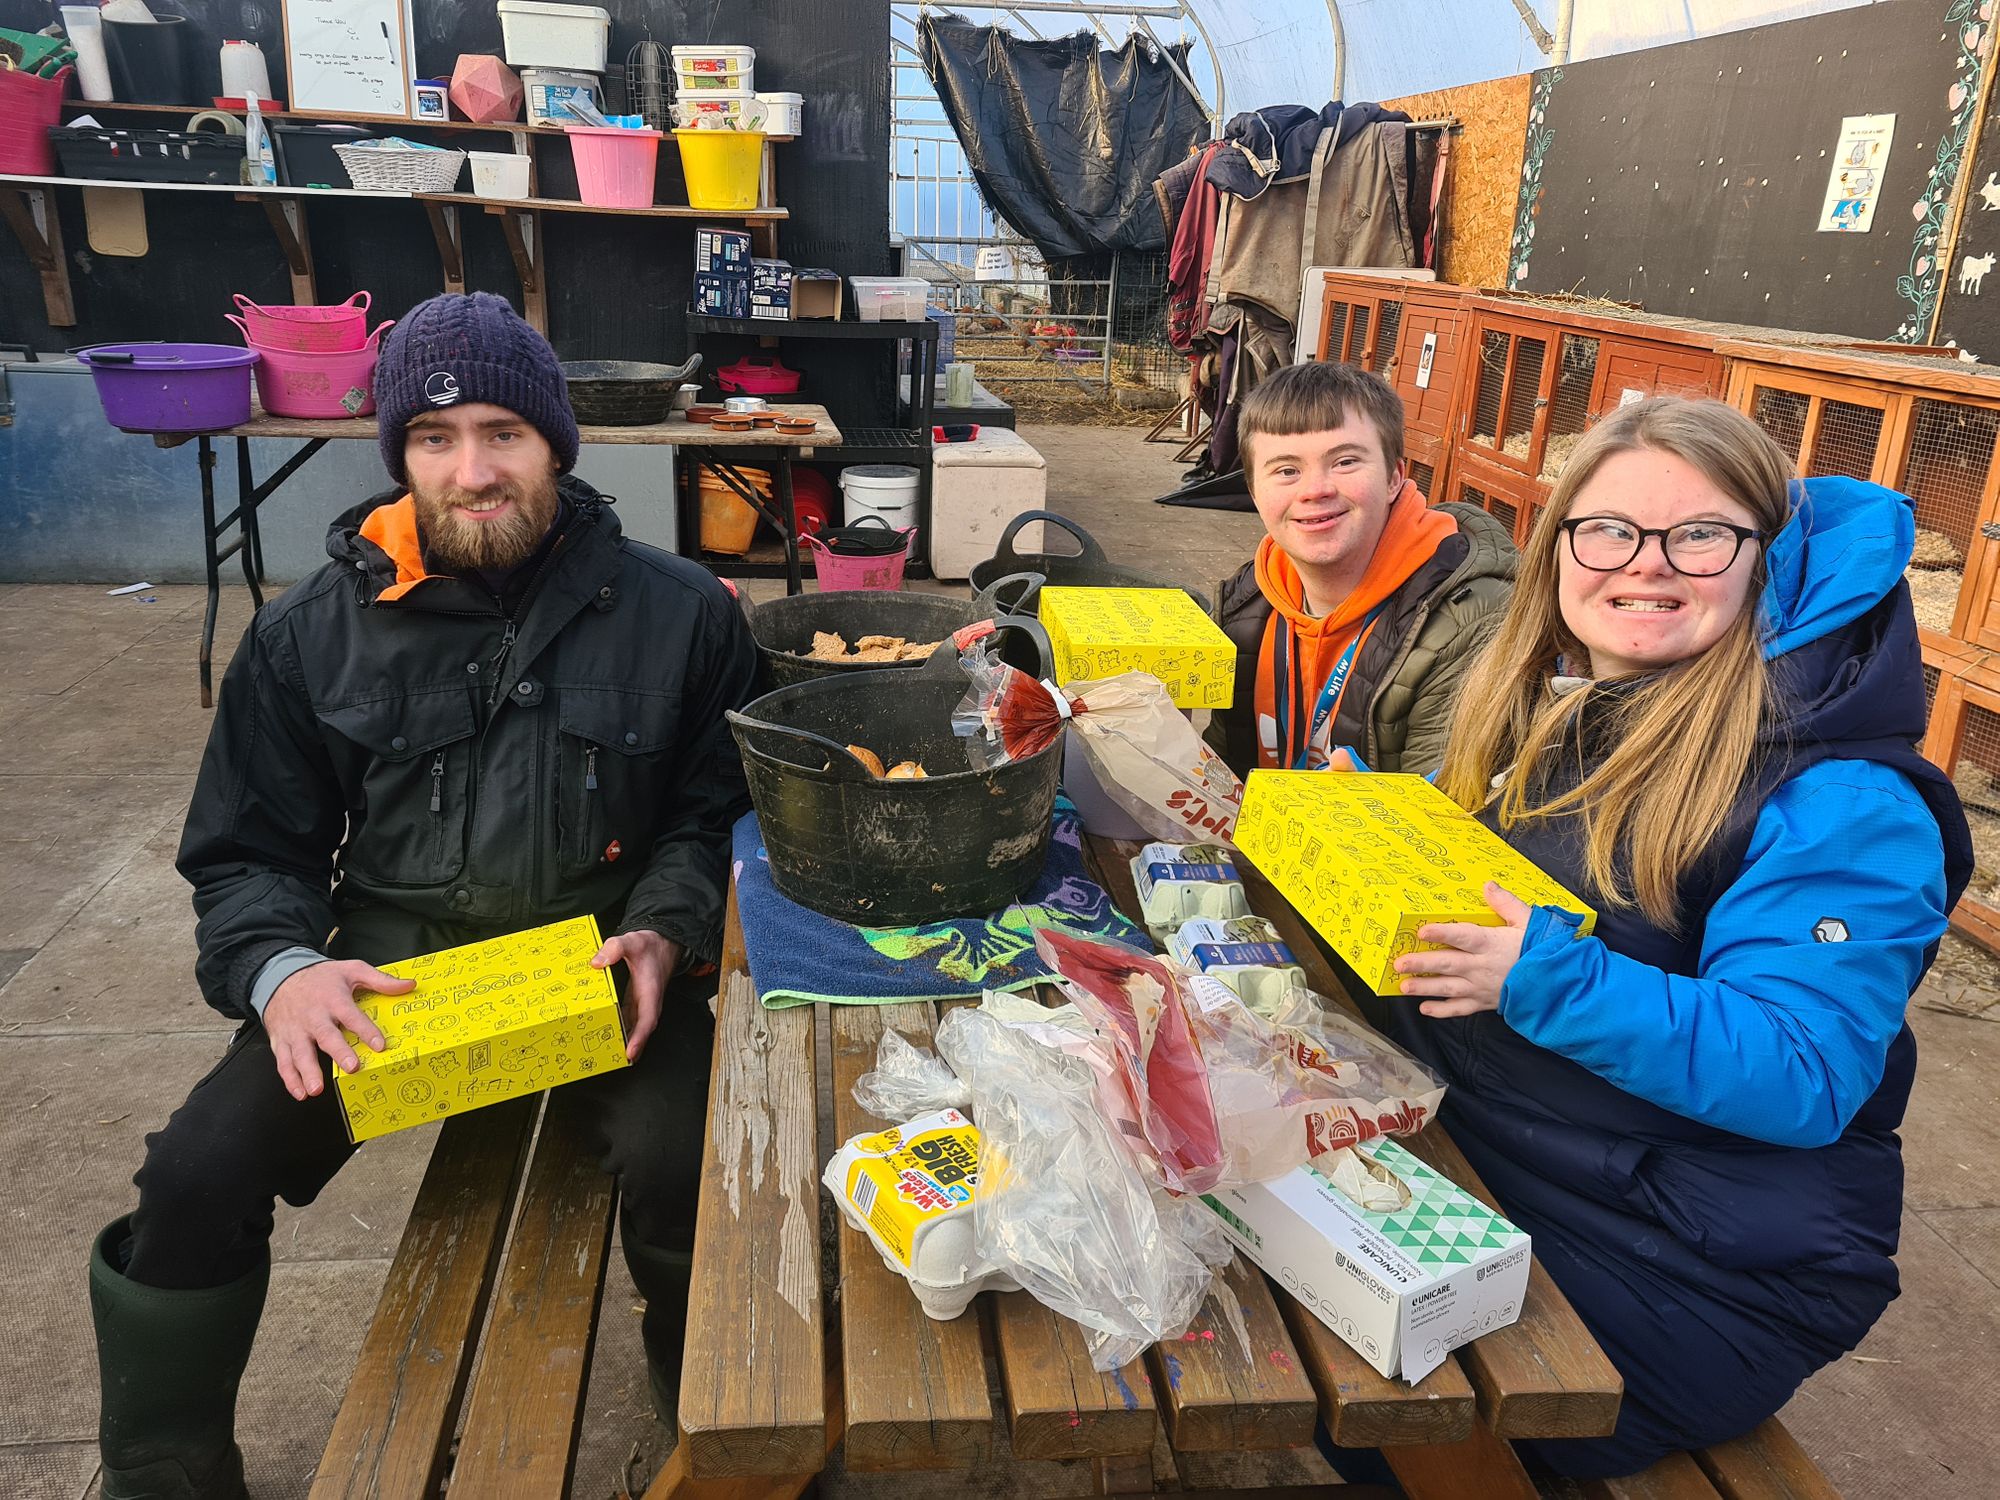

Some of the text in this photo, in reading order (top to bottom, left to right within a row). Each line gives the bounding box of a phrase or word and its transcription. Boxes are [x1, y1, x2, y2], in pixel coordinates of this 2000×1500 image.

[1327, 659, 1349, 696] My Life
[1356, 797, 1399, 825] day
[1384, 827, 1455, 867] good
[454, 971, 528, 1004] good
[393, 994, 448, 1016] day
[911, 1140, 967, 1185] BIG
[936, 1134, 977, 1168] FRESH
[904, 1171, 929, 1191] EGGS
[898, 1182, 934, 1209] WIN
[925, 1188, 953, 1208] FREE
[1316, 1188, 1335, 1203] gloves
[1357, 1242, 1400, 1277] UNICARE
[1395, 1263, 1417, 1279] LATEX
[1411, 1303, 1425, 1315] LATEX
[1428, 1294, 1448, 1309] POWDER
[1417, 1283, 1451, 1304] UNICARE
